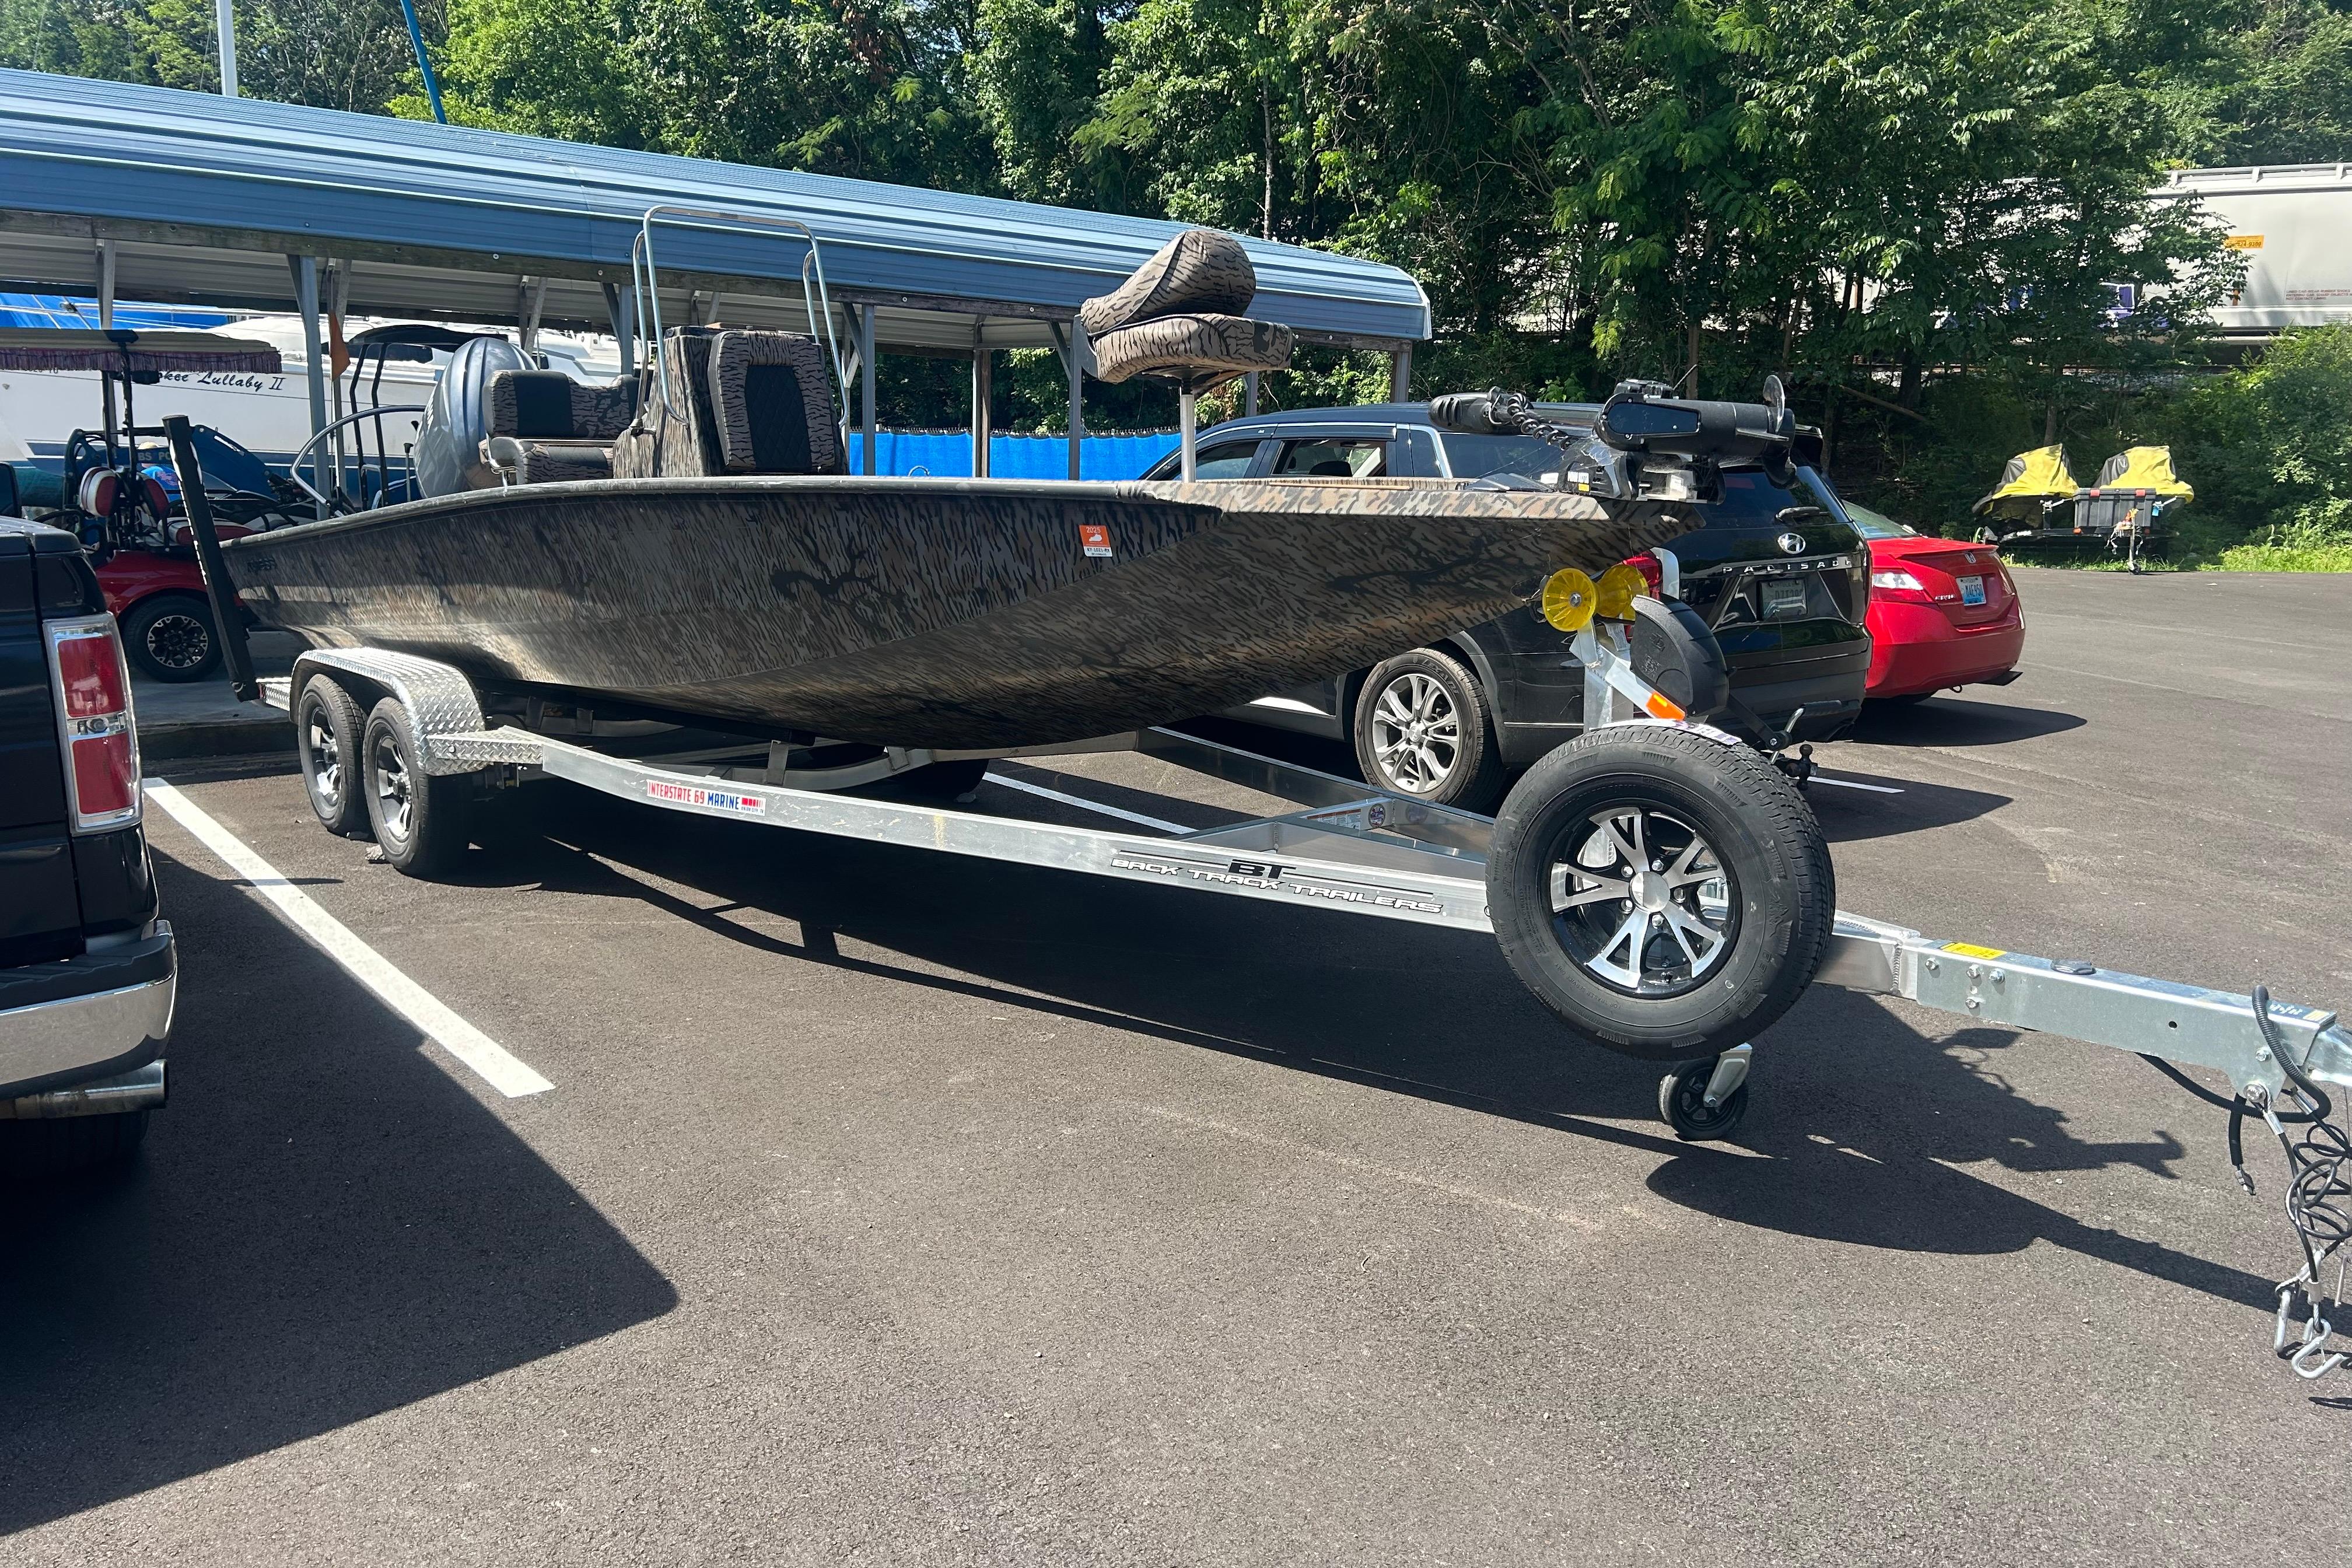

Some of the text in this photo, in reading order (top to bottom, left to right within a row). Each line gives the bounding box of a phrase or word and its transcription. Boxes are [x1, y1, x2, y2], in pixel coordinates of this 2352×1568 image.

[159, 370, 286, 392] okee Lullaby II
[1722, 559, 1852, 573] PALISADE
[648, 782, 739, 810] INTERSTATE 69 MARINE
[1228, 859, 1296, 878] BT
[1111, 858, 1443, 913] BACK TRACK TRAILERS
